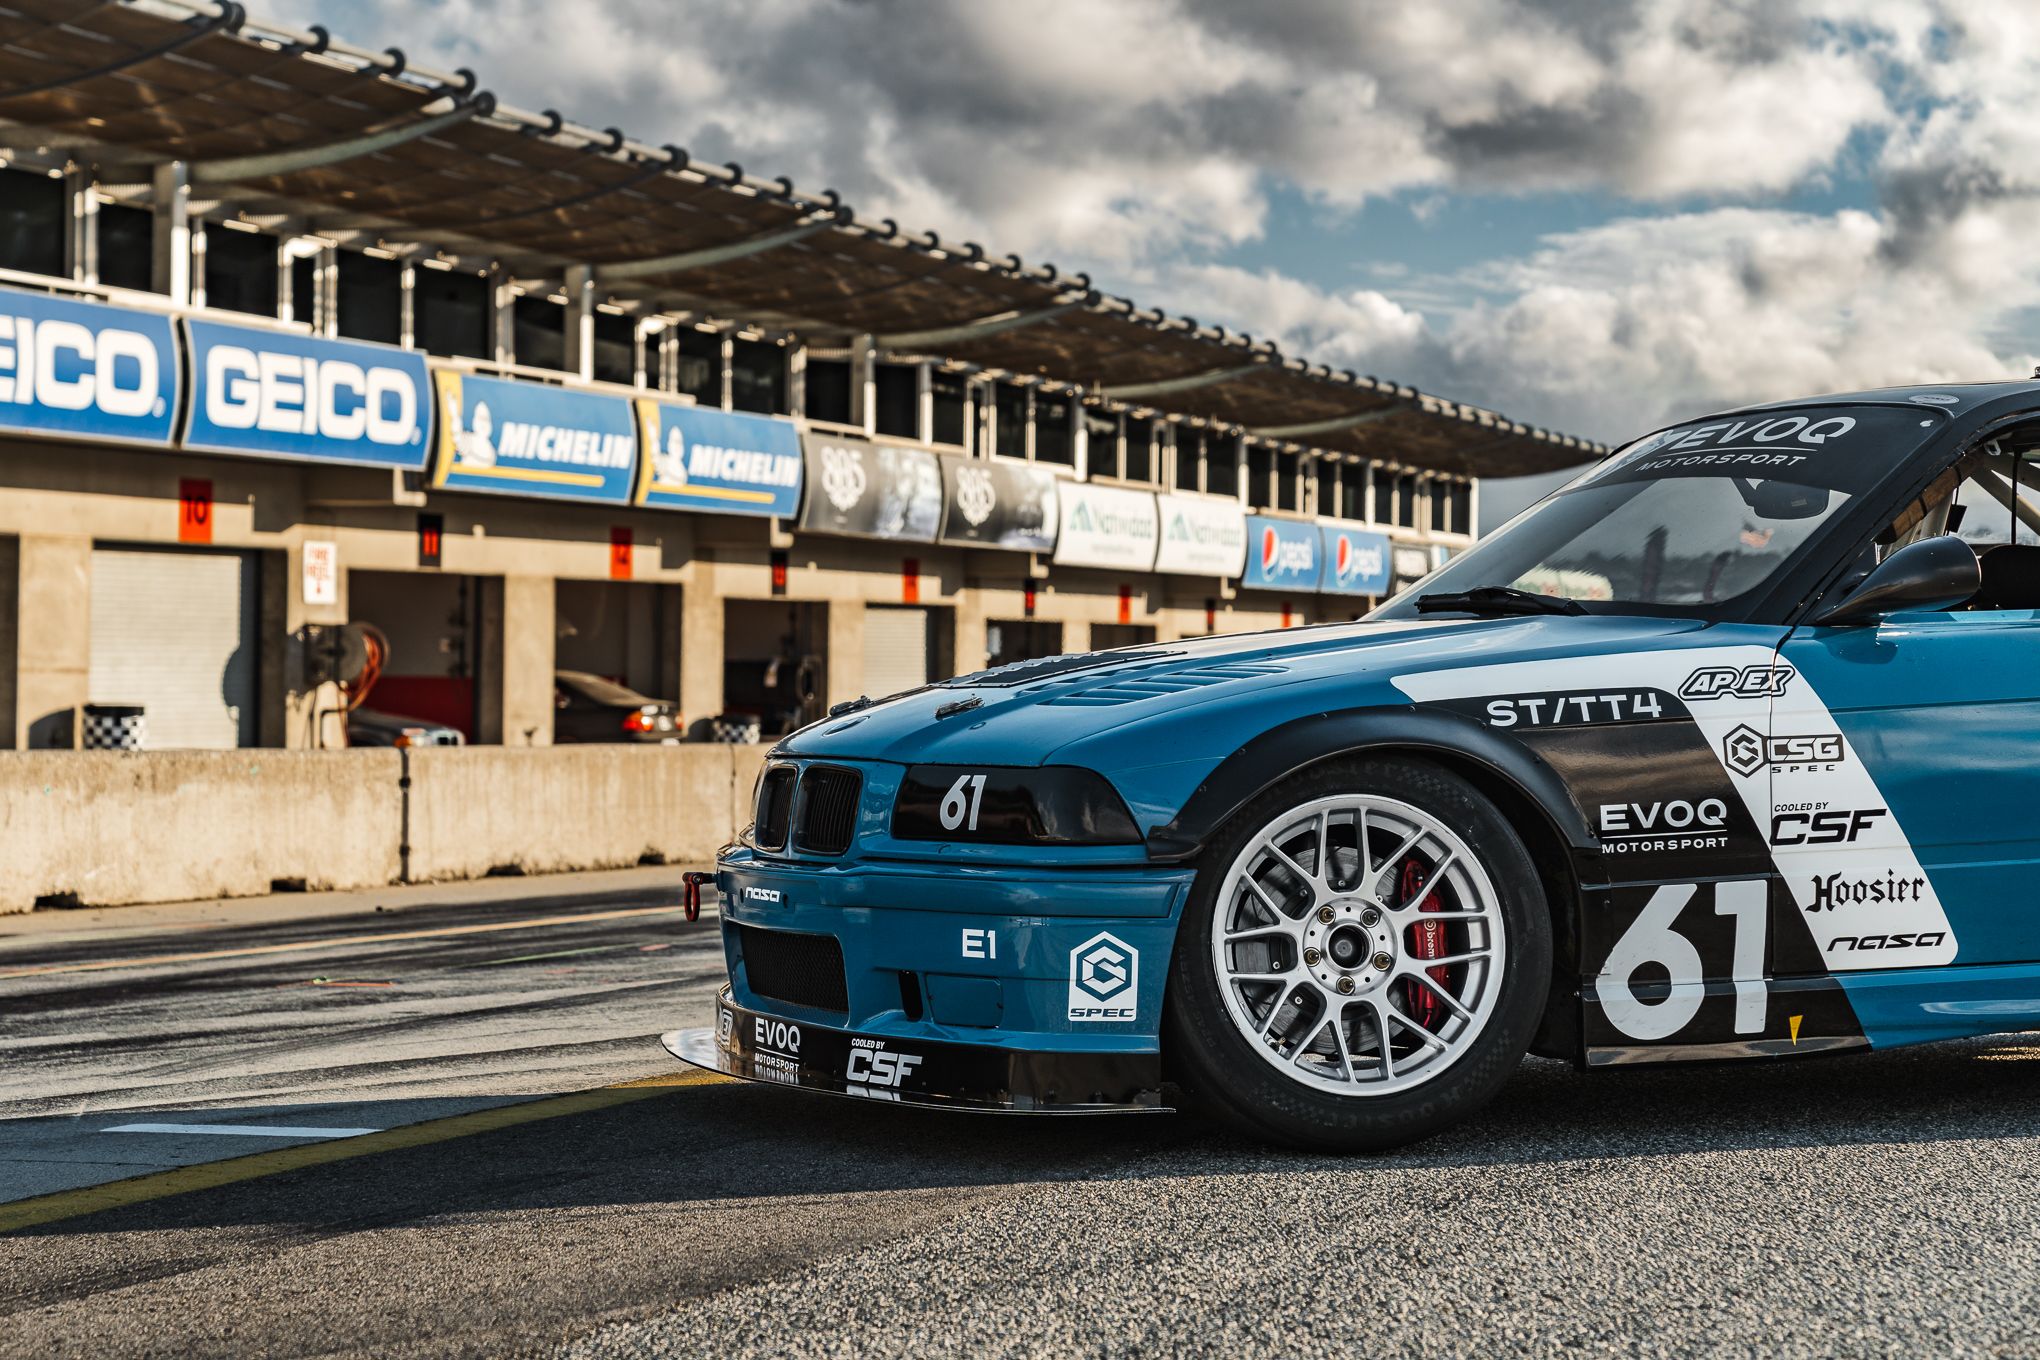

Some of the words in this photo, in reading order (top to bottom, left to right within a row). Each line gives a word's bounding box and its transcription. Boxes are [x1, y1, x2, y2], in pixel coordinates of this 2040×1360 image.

[206, 344, 417, 445] GEICO
[499, 421, 633, 469] MICHELIN
[1668, 417, 1857, 450] EVOQ
[688, 444, 800, 488] MICHELIN
[1635, 454, 1807, 471] MOTORSPORT
[1486, 693, 1663, 727] ST/TT4
[1766, 736, 1840, 761] CSG
[1771, 764, 1836, 773] SPEC
[939, 774, 986, 831] 61
[1600, 799, 1727, 831] EVOQ
[1774, 803, 1812, 812] COOLED
[1815, 802, 1829, 810] BY
[1769, 809, 1886, 846] CSF
[1601, 837, 1728, 854] MOTORSPORT
[1805, 868, 1924, 913] Hoosier
[962, 928, 996, 959] E1
[1426, 932, 1435, 960] brem
[1595, 880, 1767, 1041] 61
[1070, 1008, 1134, 1017] SPEC
[755, 1017, 801, 1053] EVOQ
[851, 1038, 875, 1048] COOLED
[876, 1041, 885, 1049] BY
[754, 1053, 800, 1073] MOTORSPORT
[846, 1048, 923, 1087] CSF
